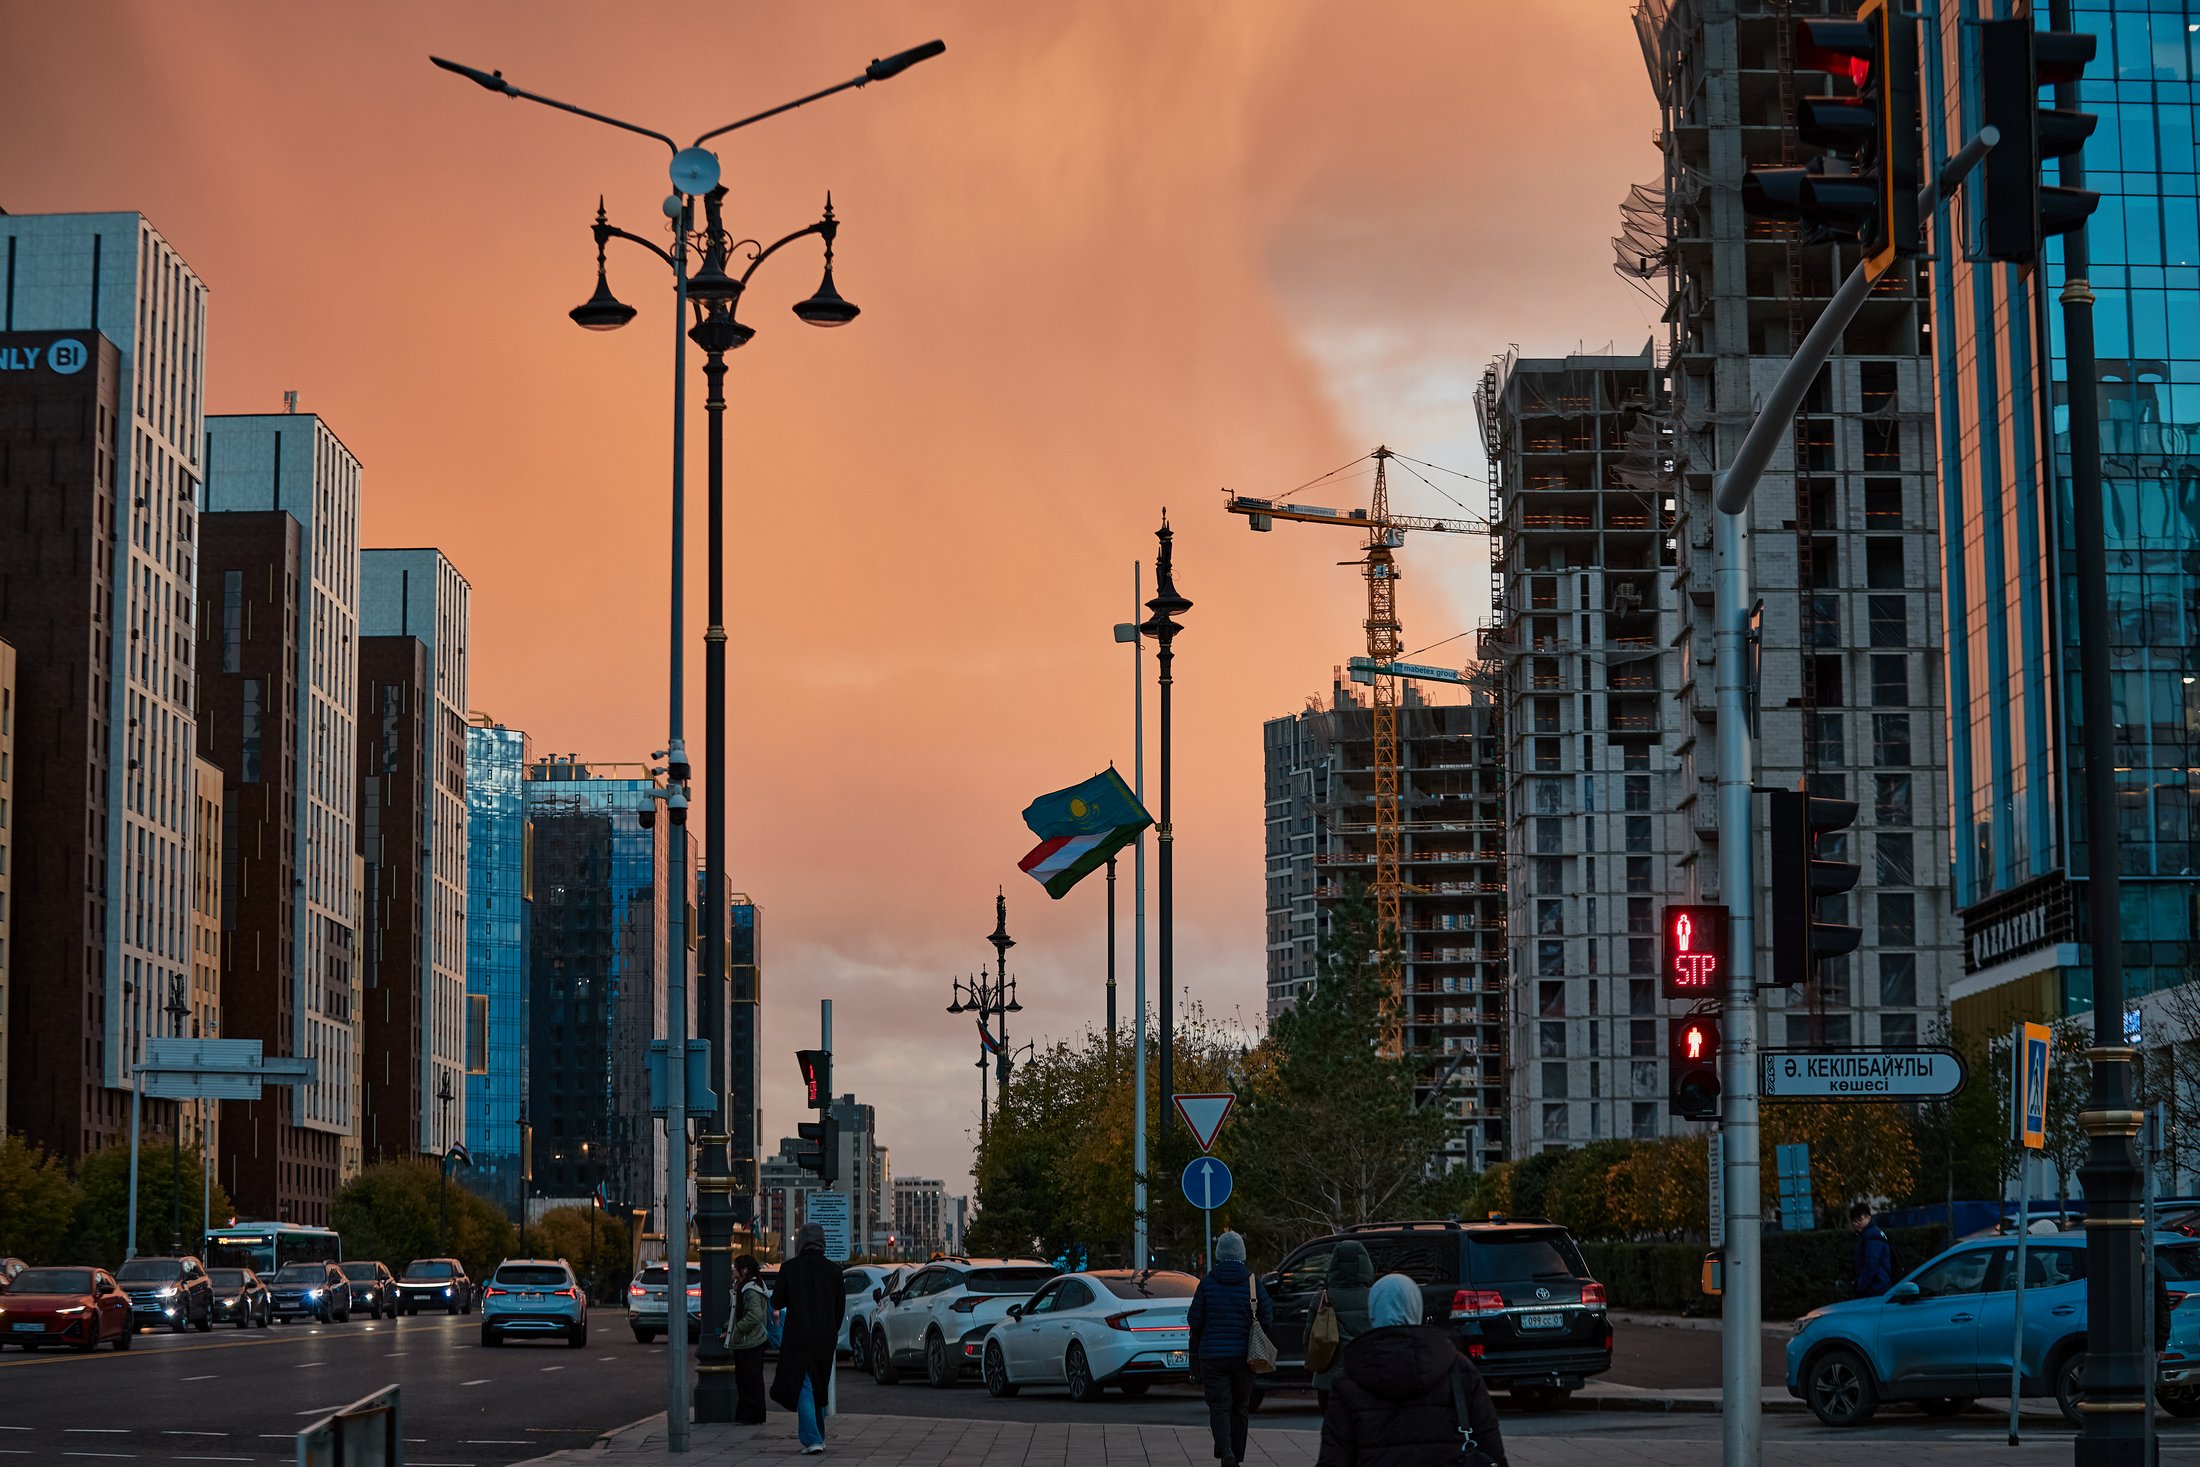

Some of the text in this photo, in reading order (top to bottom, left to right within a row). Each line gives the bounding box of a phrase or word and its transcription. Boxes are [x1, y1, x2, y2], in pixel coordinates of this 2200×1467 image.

[56, 346, 79, 366] BI
[1377, 566, 1384, 576] 4
[1403, 665, 1458, 679] mabetex group
[1973, 905, 2046, 968] QAZPATENT
[1676, 955, 1716, 985] STP
[1784, 1055, 1933, 1078] Ә. КЕКІЛБАЙҰЛЫ
[1830, 1077, 1889, 1092] көшесі
[1528, 1315, 1542, 1325] 099
[1174, 1354, 1189, 1364] 257
